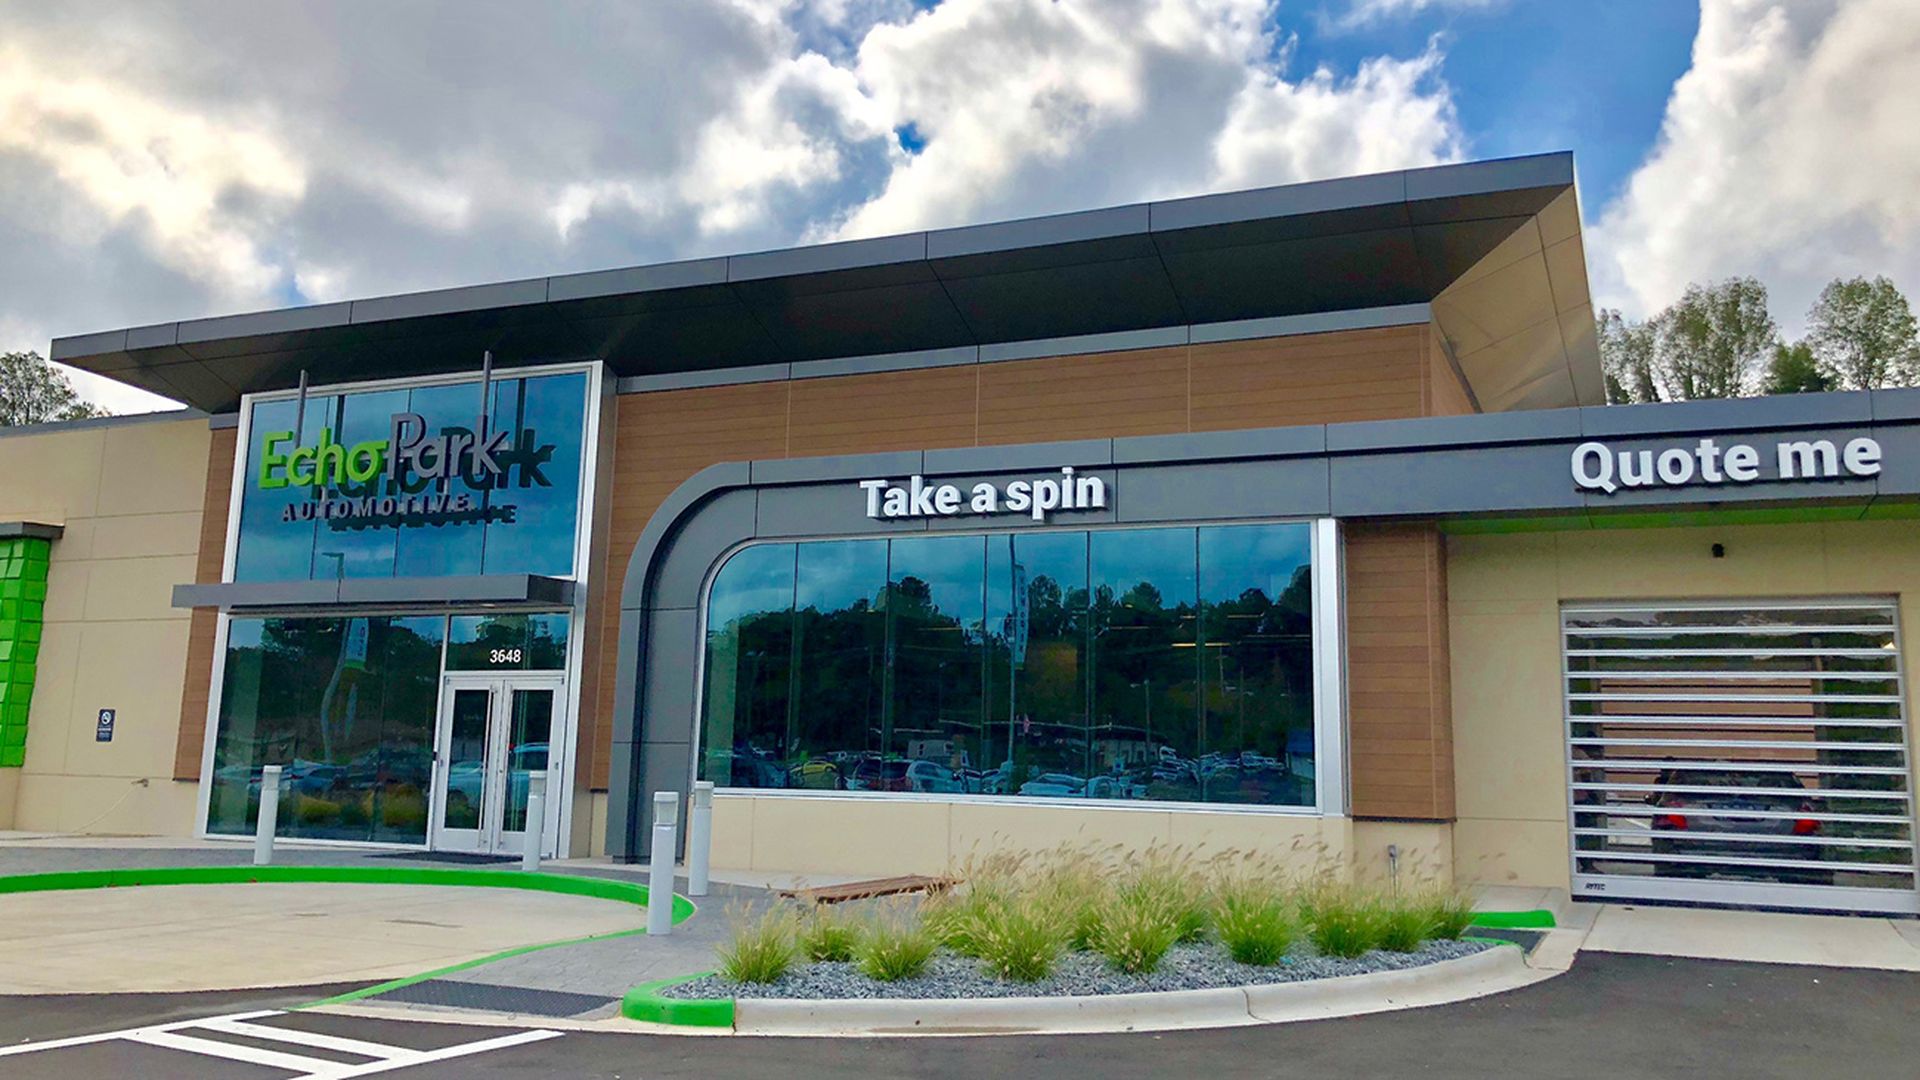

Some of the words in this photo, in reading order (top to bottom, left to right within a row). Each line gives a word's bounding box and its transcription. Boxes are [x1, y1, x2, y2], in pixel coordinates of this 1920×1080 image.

[260, 413, 508, 489] EchoPark
[1571, 439, 1760, 493] Quote
[1777, 437, 1882, 479] me
[283, 493, 472, 522] AUTOMOTIVE
[860, 475, 962, 517] Take
[971, 482, 998, 512] a
[1005, 466, 1106, 521] spin
[489, 649, 521, 663] 3648
